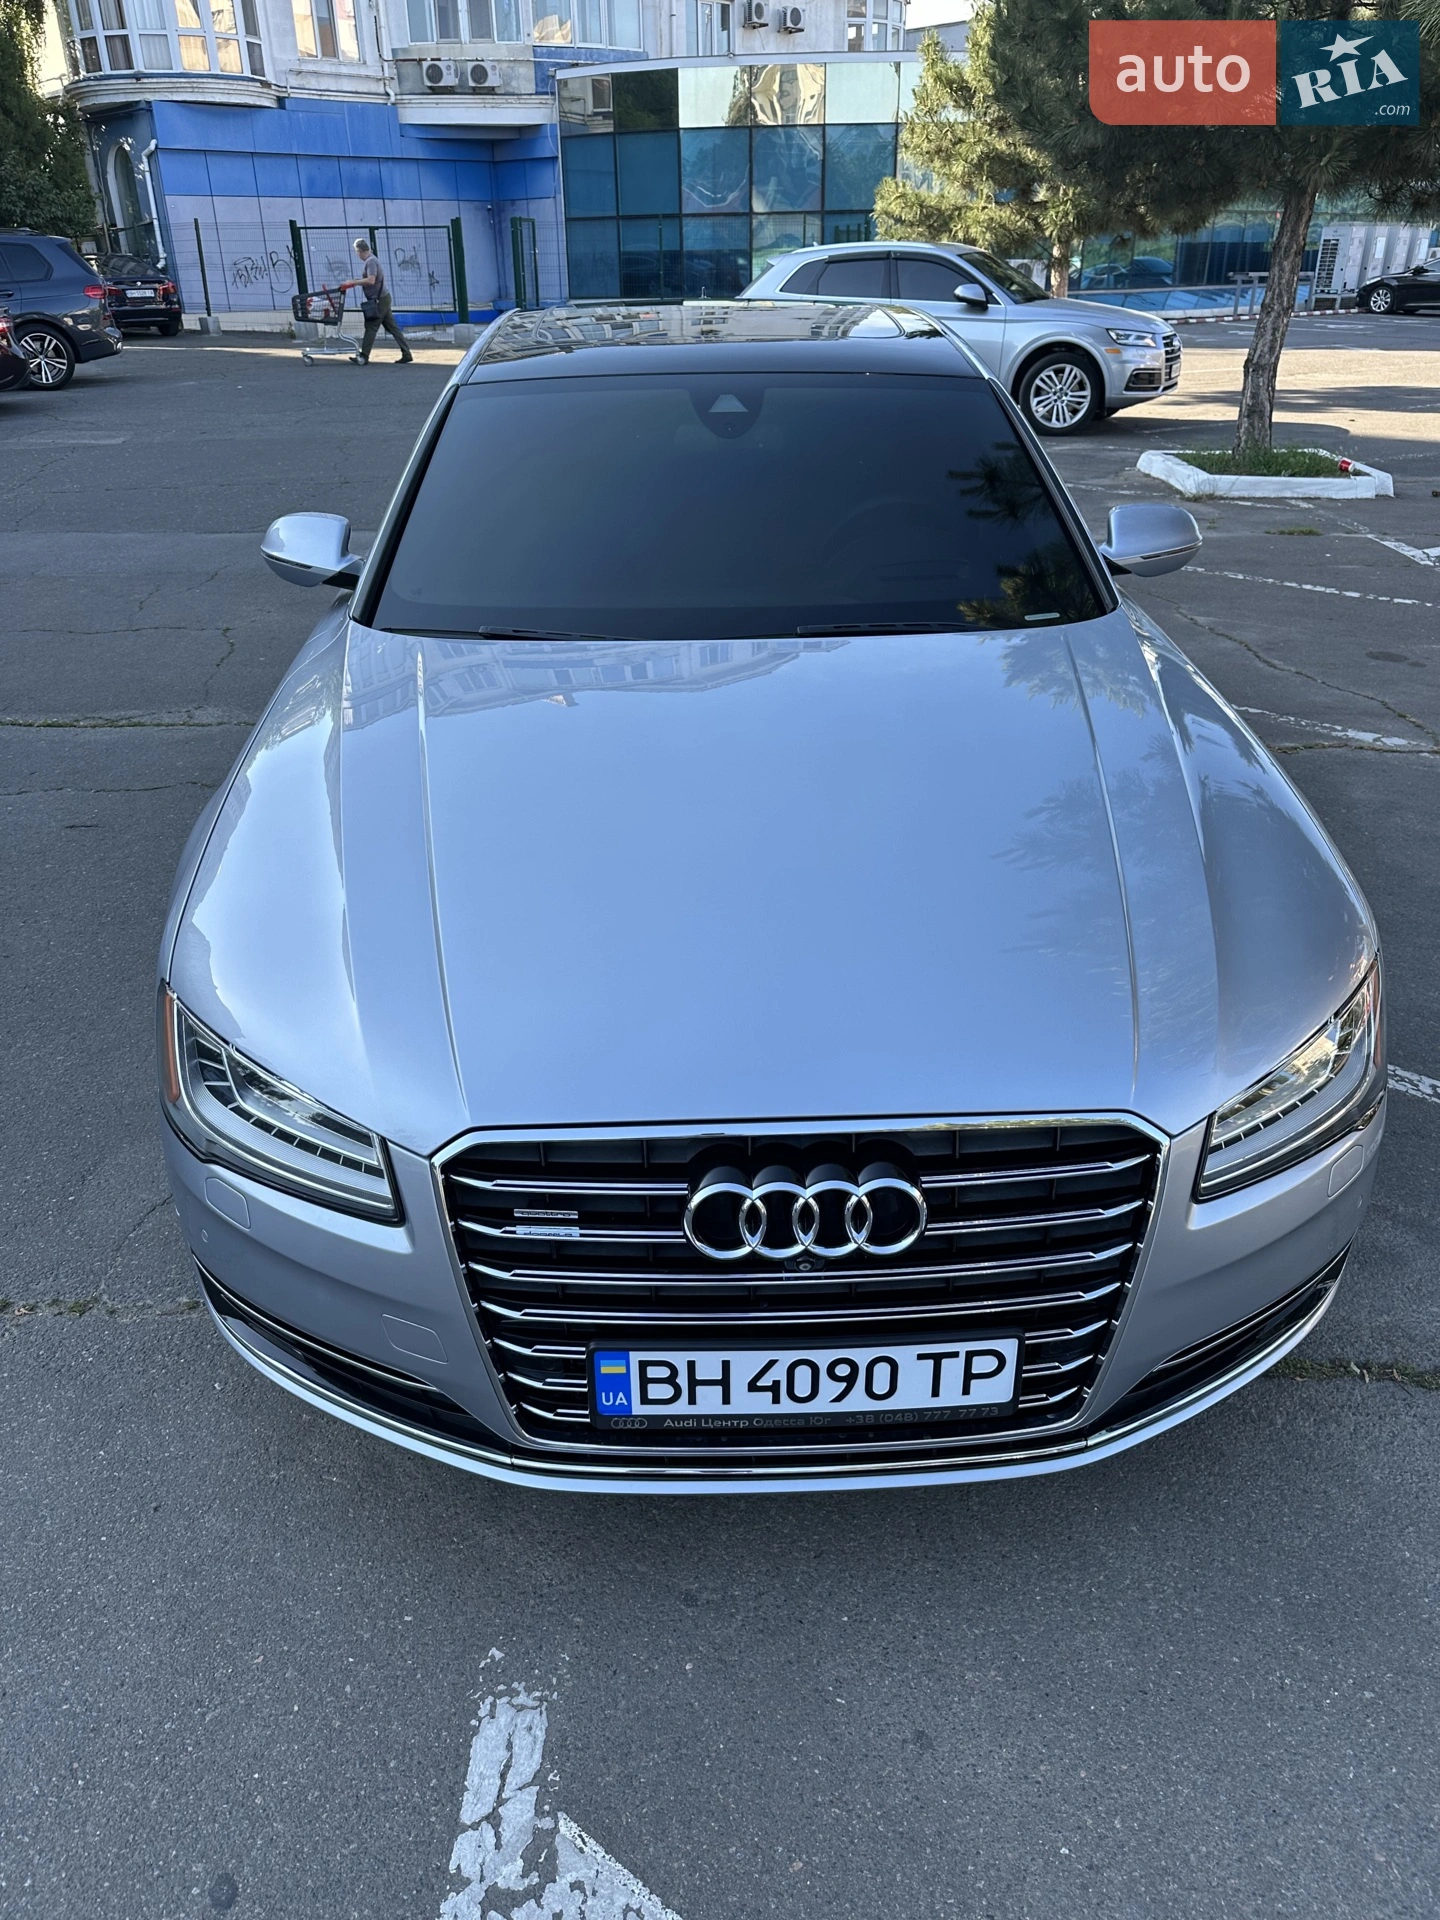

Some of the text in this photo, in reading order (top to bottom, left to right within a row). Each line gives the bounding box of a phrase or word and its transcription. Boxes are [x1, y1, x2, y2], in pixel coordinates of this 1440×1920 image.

[638, 1348, 1007, 1406] BH 4090 TP
[601, 1391, 628, 1406] UA
[663, 1418, 697, 1428] Audi
[701, 1418, 749, 1429] Центр
[752, 1416, 805, 1427] Одесса
[845, 1414, 875, 1424] +38
[879, 1411, 919, 1423] (048)
[923, 1410, 951, 1420] 777
[958, 1408, 975, 1418] 77
[981, 1406, 999, 1416] 73
